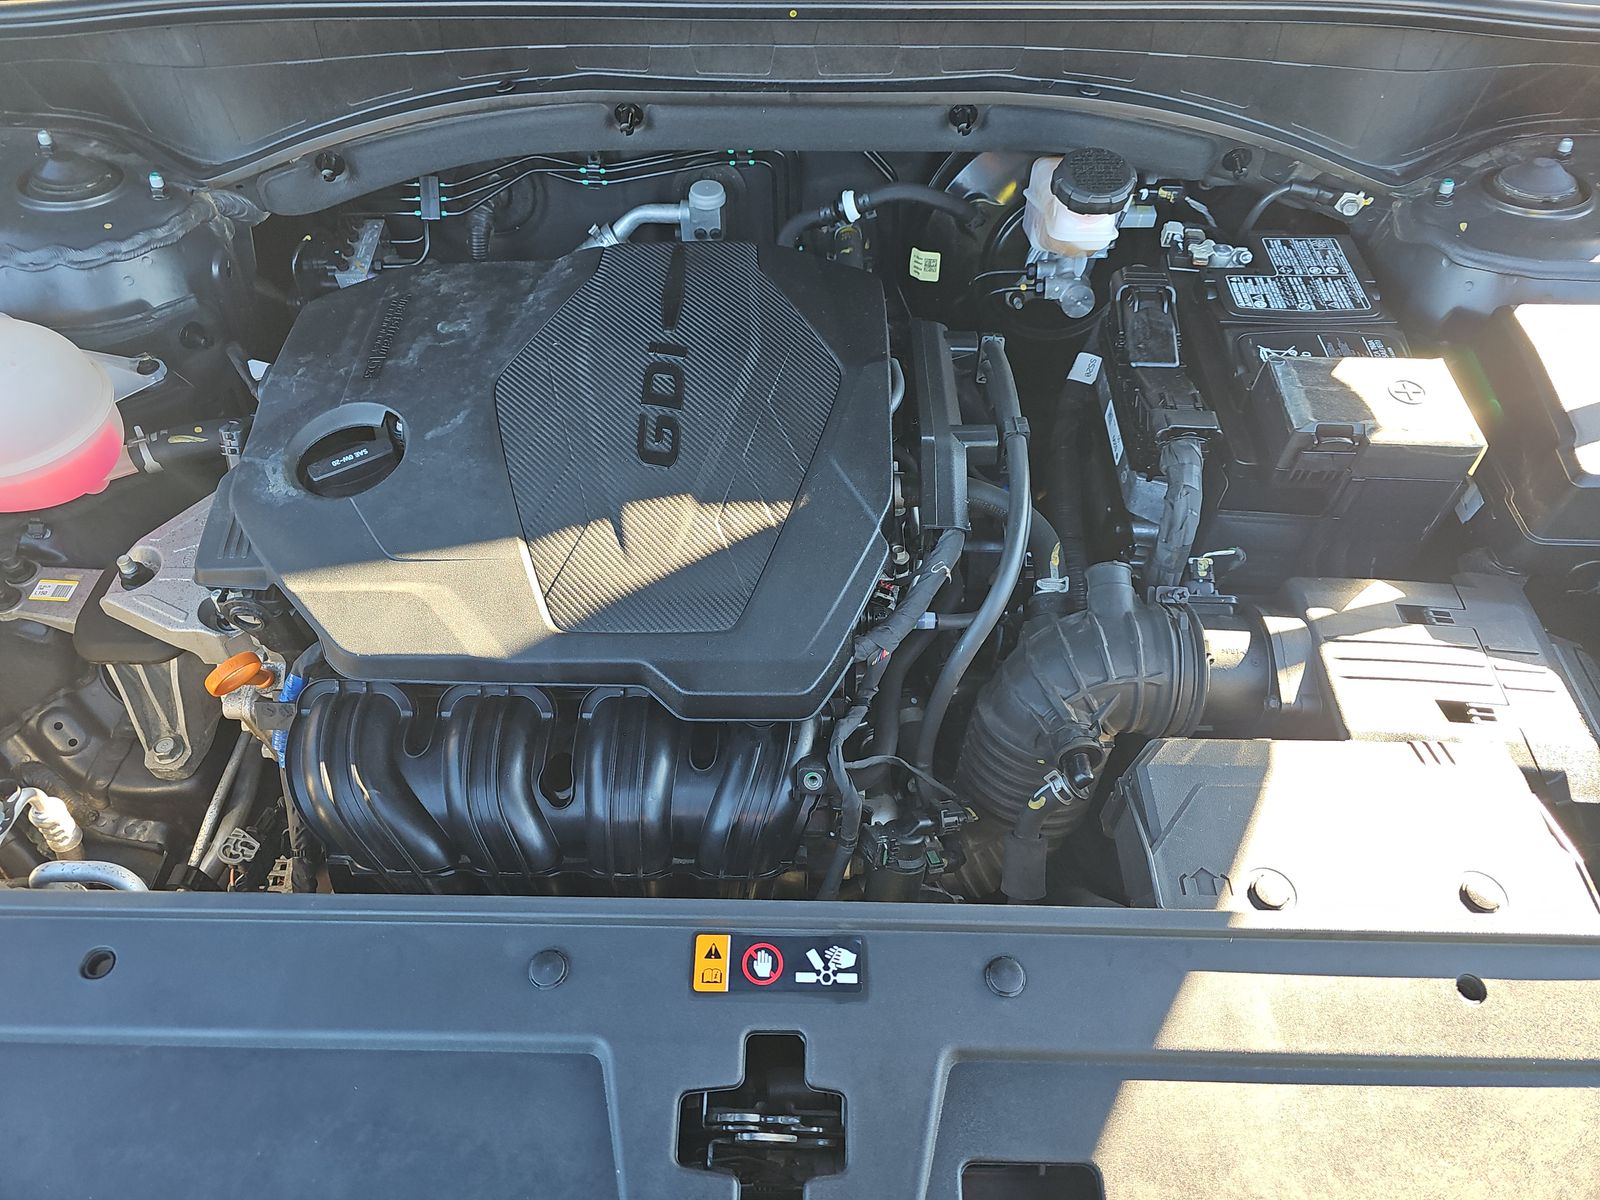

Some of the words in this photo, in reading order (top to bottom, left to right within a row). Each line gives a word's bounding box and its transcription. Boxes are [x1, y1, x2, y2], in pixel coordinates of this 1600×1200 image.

[637, 340, 688, 469] GDI
[353, 448, 369, 458] SAE
[331, 454, 354, 467] 0W-20
